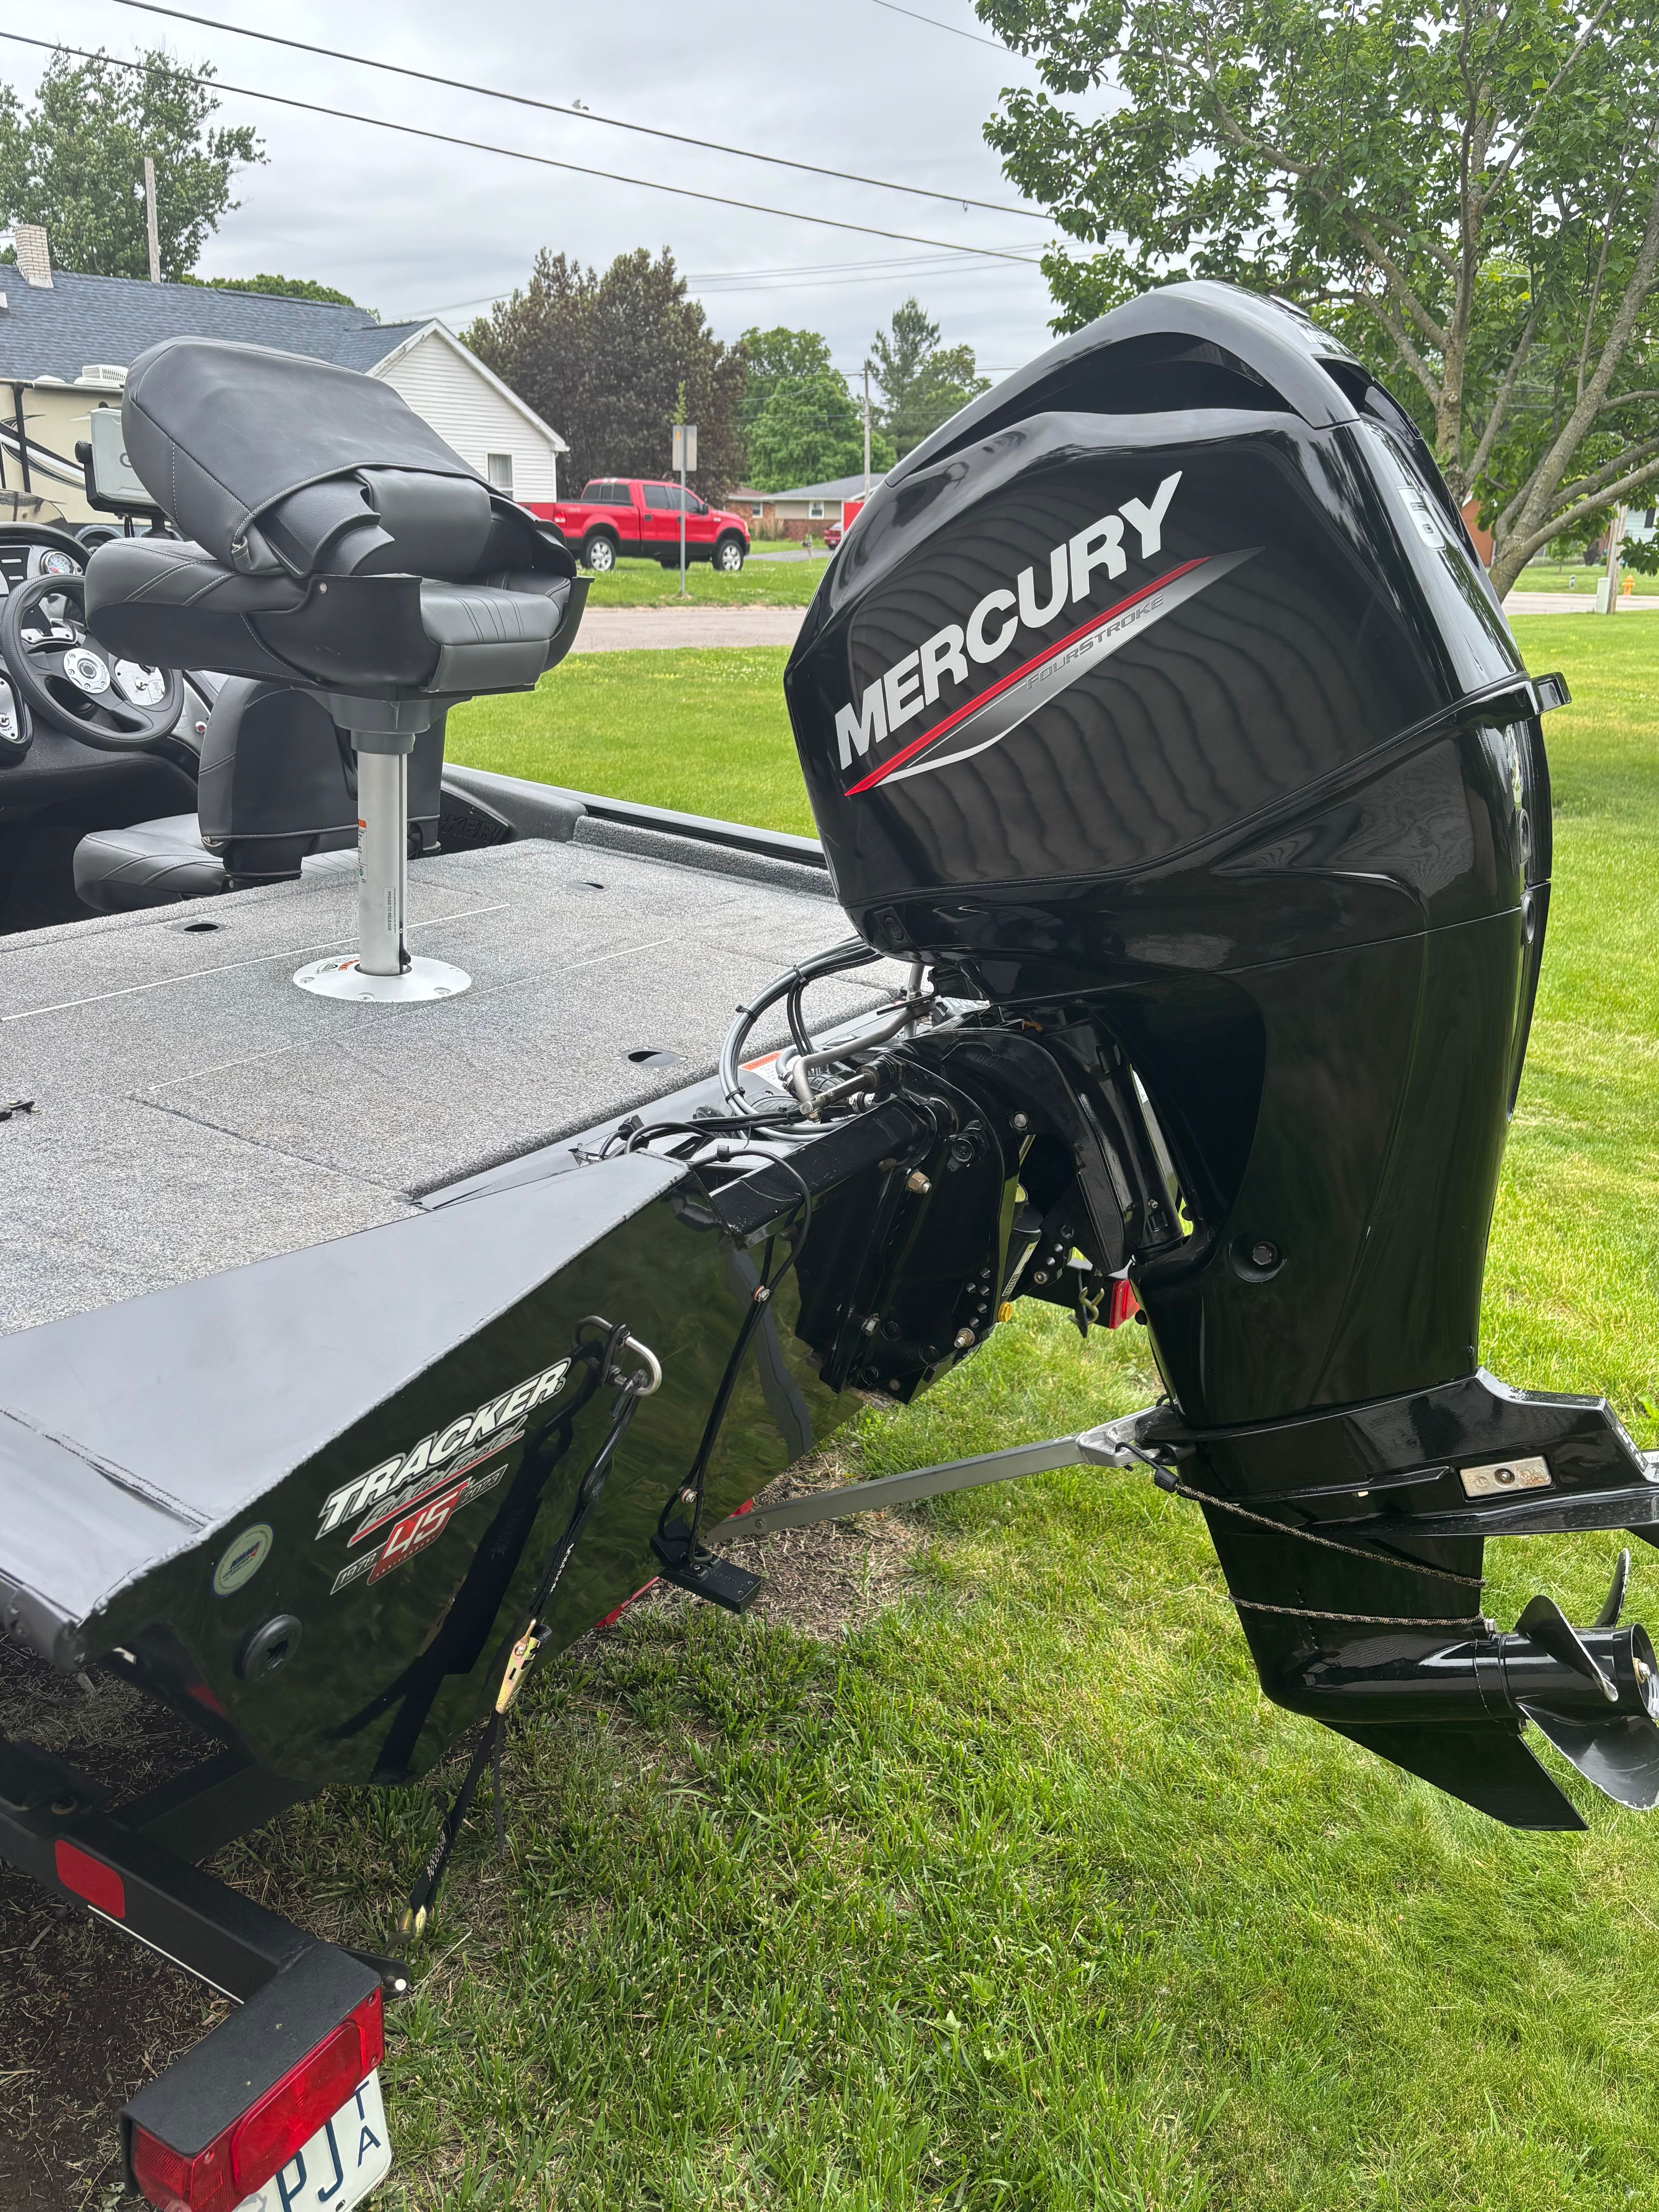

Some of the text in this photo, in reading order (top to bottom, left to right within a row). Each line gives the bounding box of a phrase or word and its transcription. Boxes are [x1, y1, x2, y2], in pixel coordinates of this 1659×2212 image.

[834, 471, 1182, 770] MERCURY
[1026, 594, 1163, 690] FOURSTROKE
[340, 1552, 377, 1584] 1978
[382, 1491, 459, 1560] 45
[461, 1472, 500, 1504] 2023
